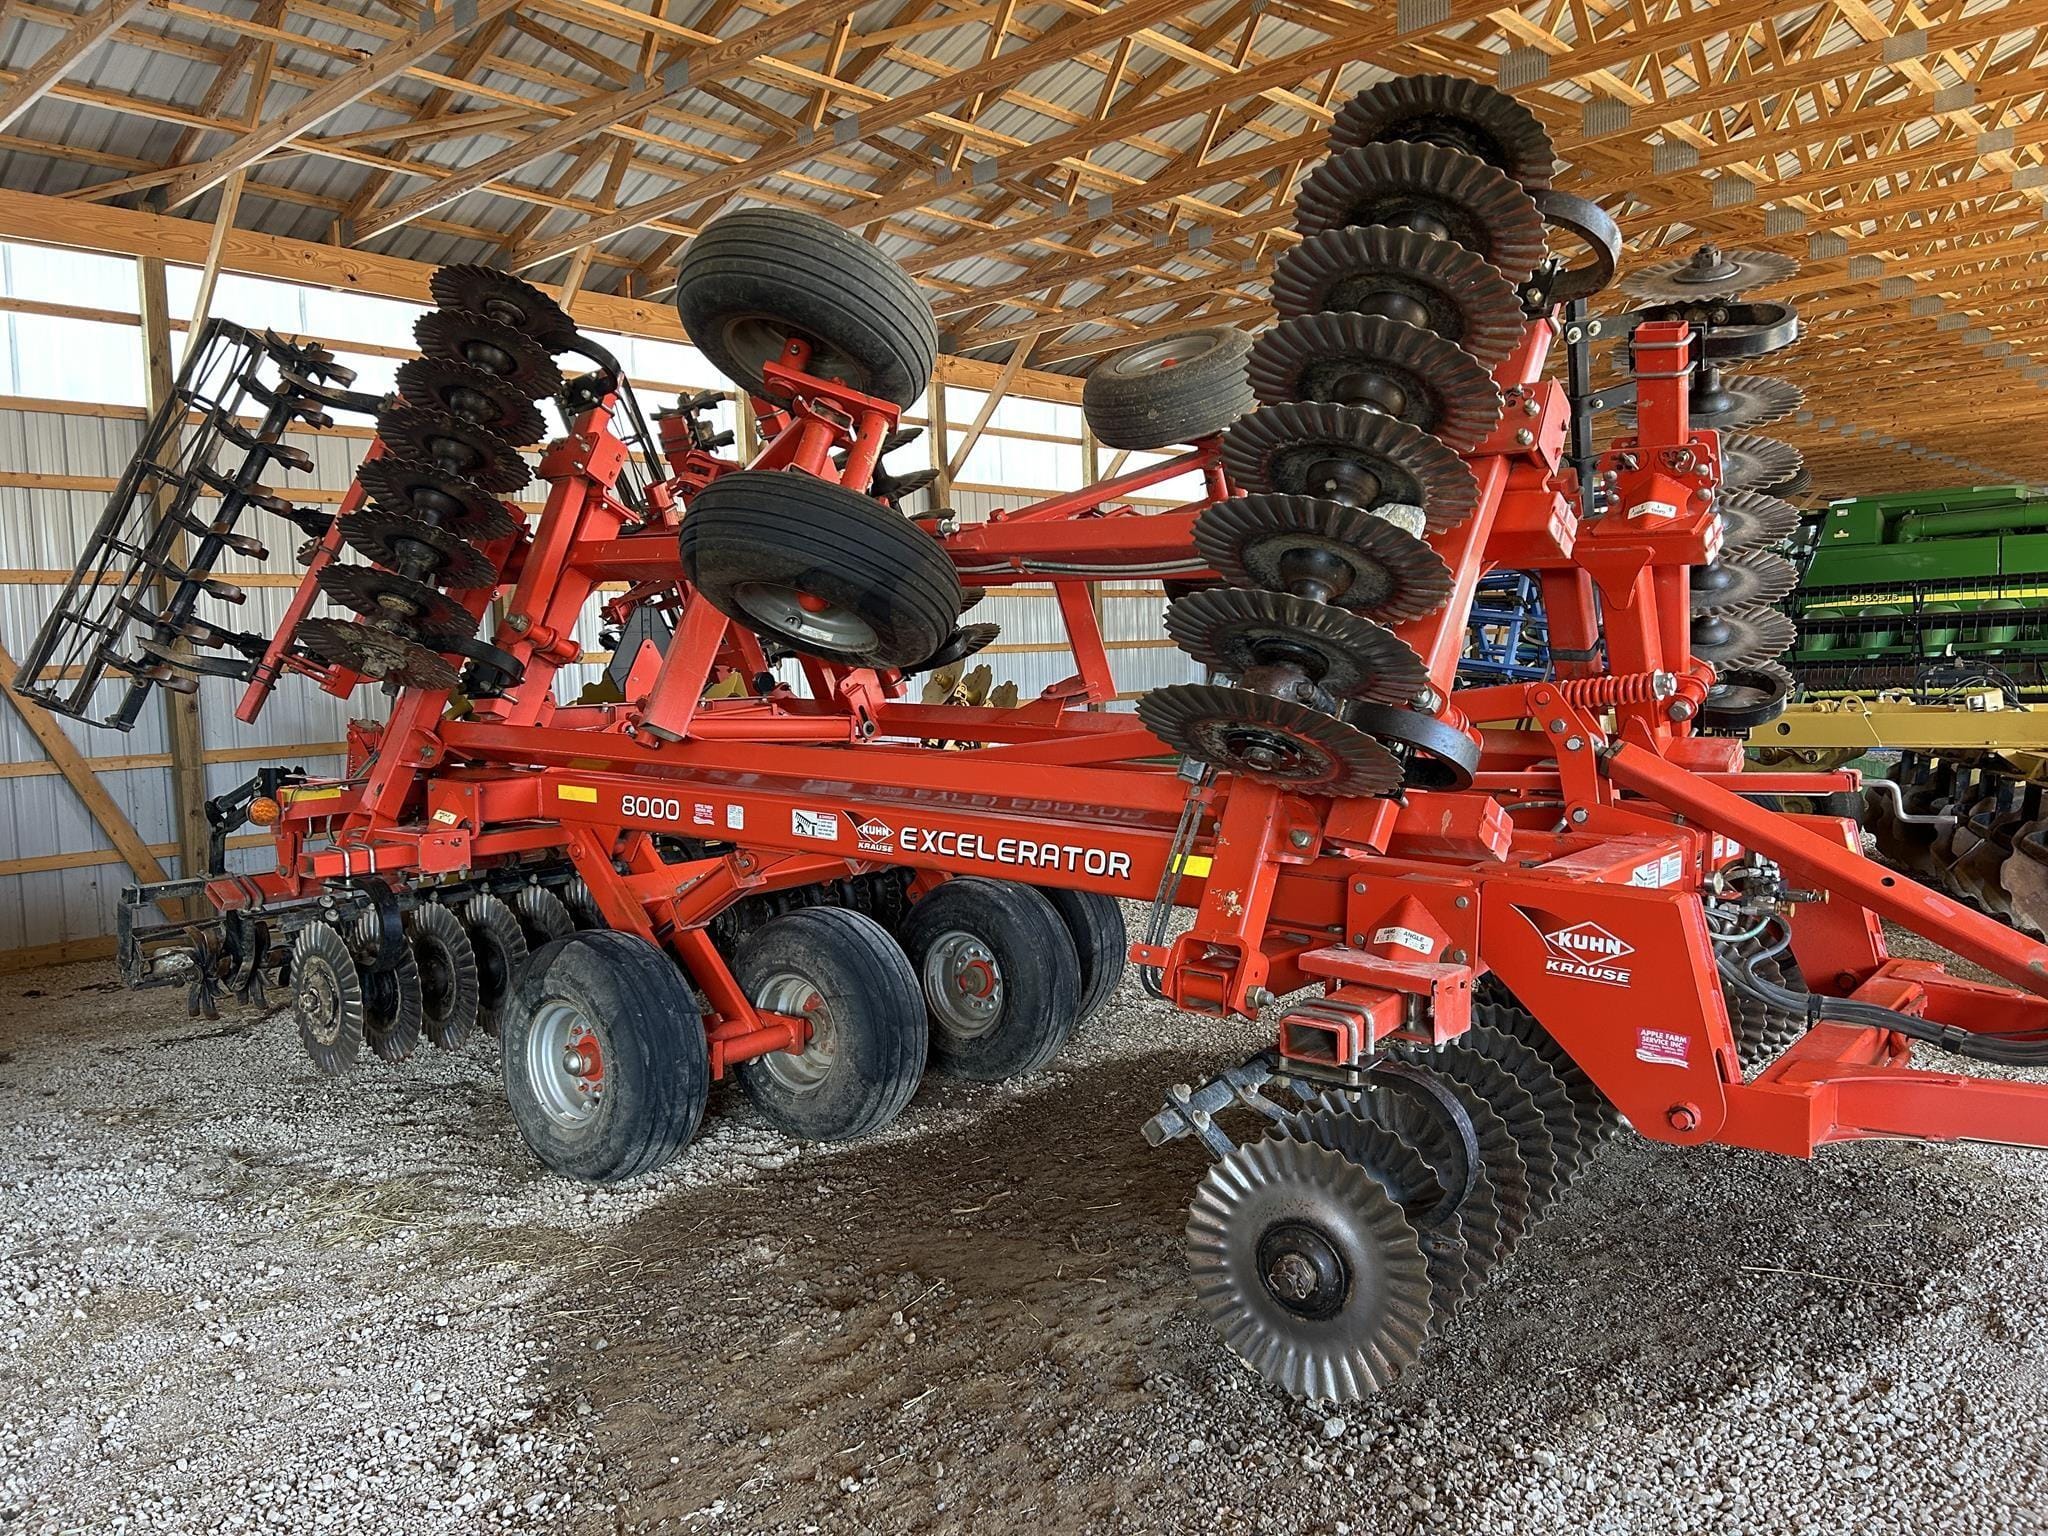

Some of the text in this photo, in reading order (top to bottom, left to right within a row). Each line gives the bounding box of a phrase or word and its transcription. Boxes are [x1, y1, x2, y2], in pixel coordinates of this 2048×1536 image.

[621, 795, 680, 820] 8000
[862, 824, 889, 838] KUHN
[857, 841, 894, 853] KRAUSE
[899, 827, 1131, 879] EXCELERATOR
[1403, 931, 1425, 942] ANGLE
[1558, 932, 1621, 956] KUHN
[1545, 960, 1631, 983] KRAUSE
[1640, 1029, 1688, 1044] APPLE FARM
[1641, 1035, 1669, 1047] SERVICE
